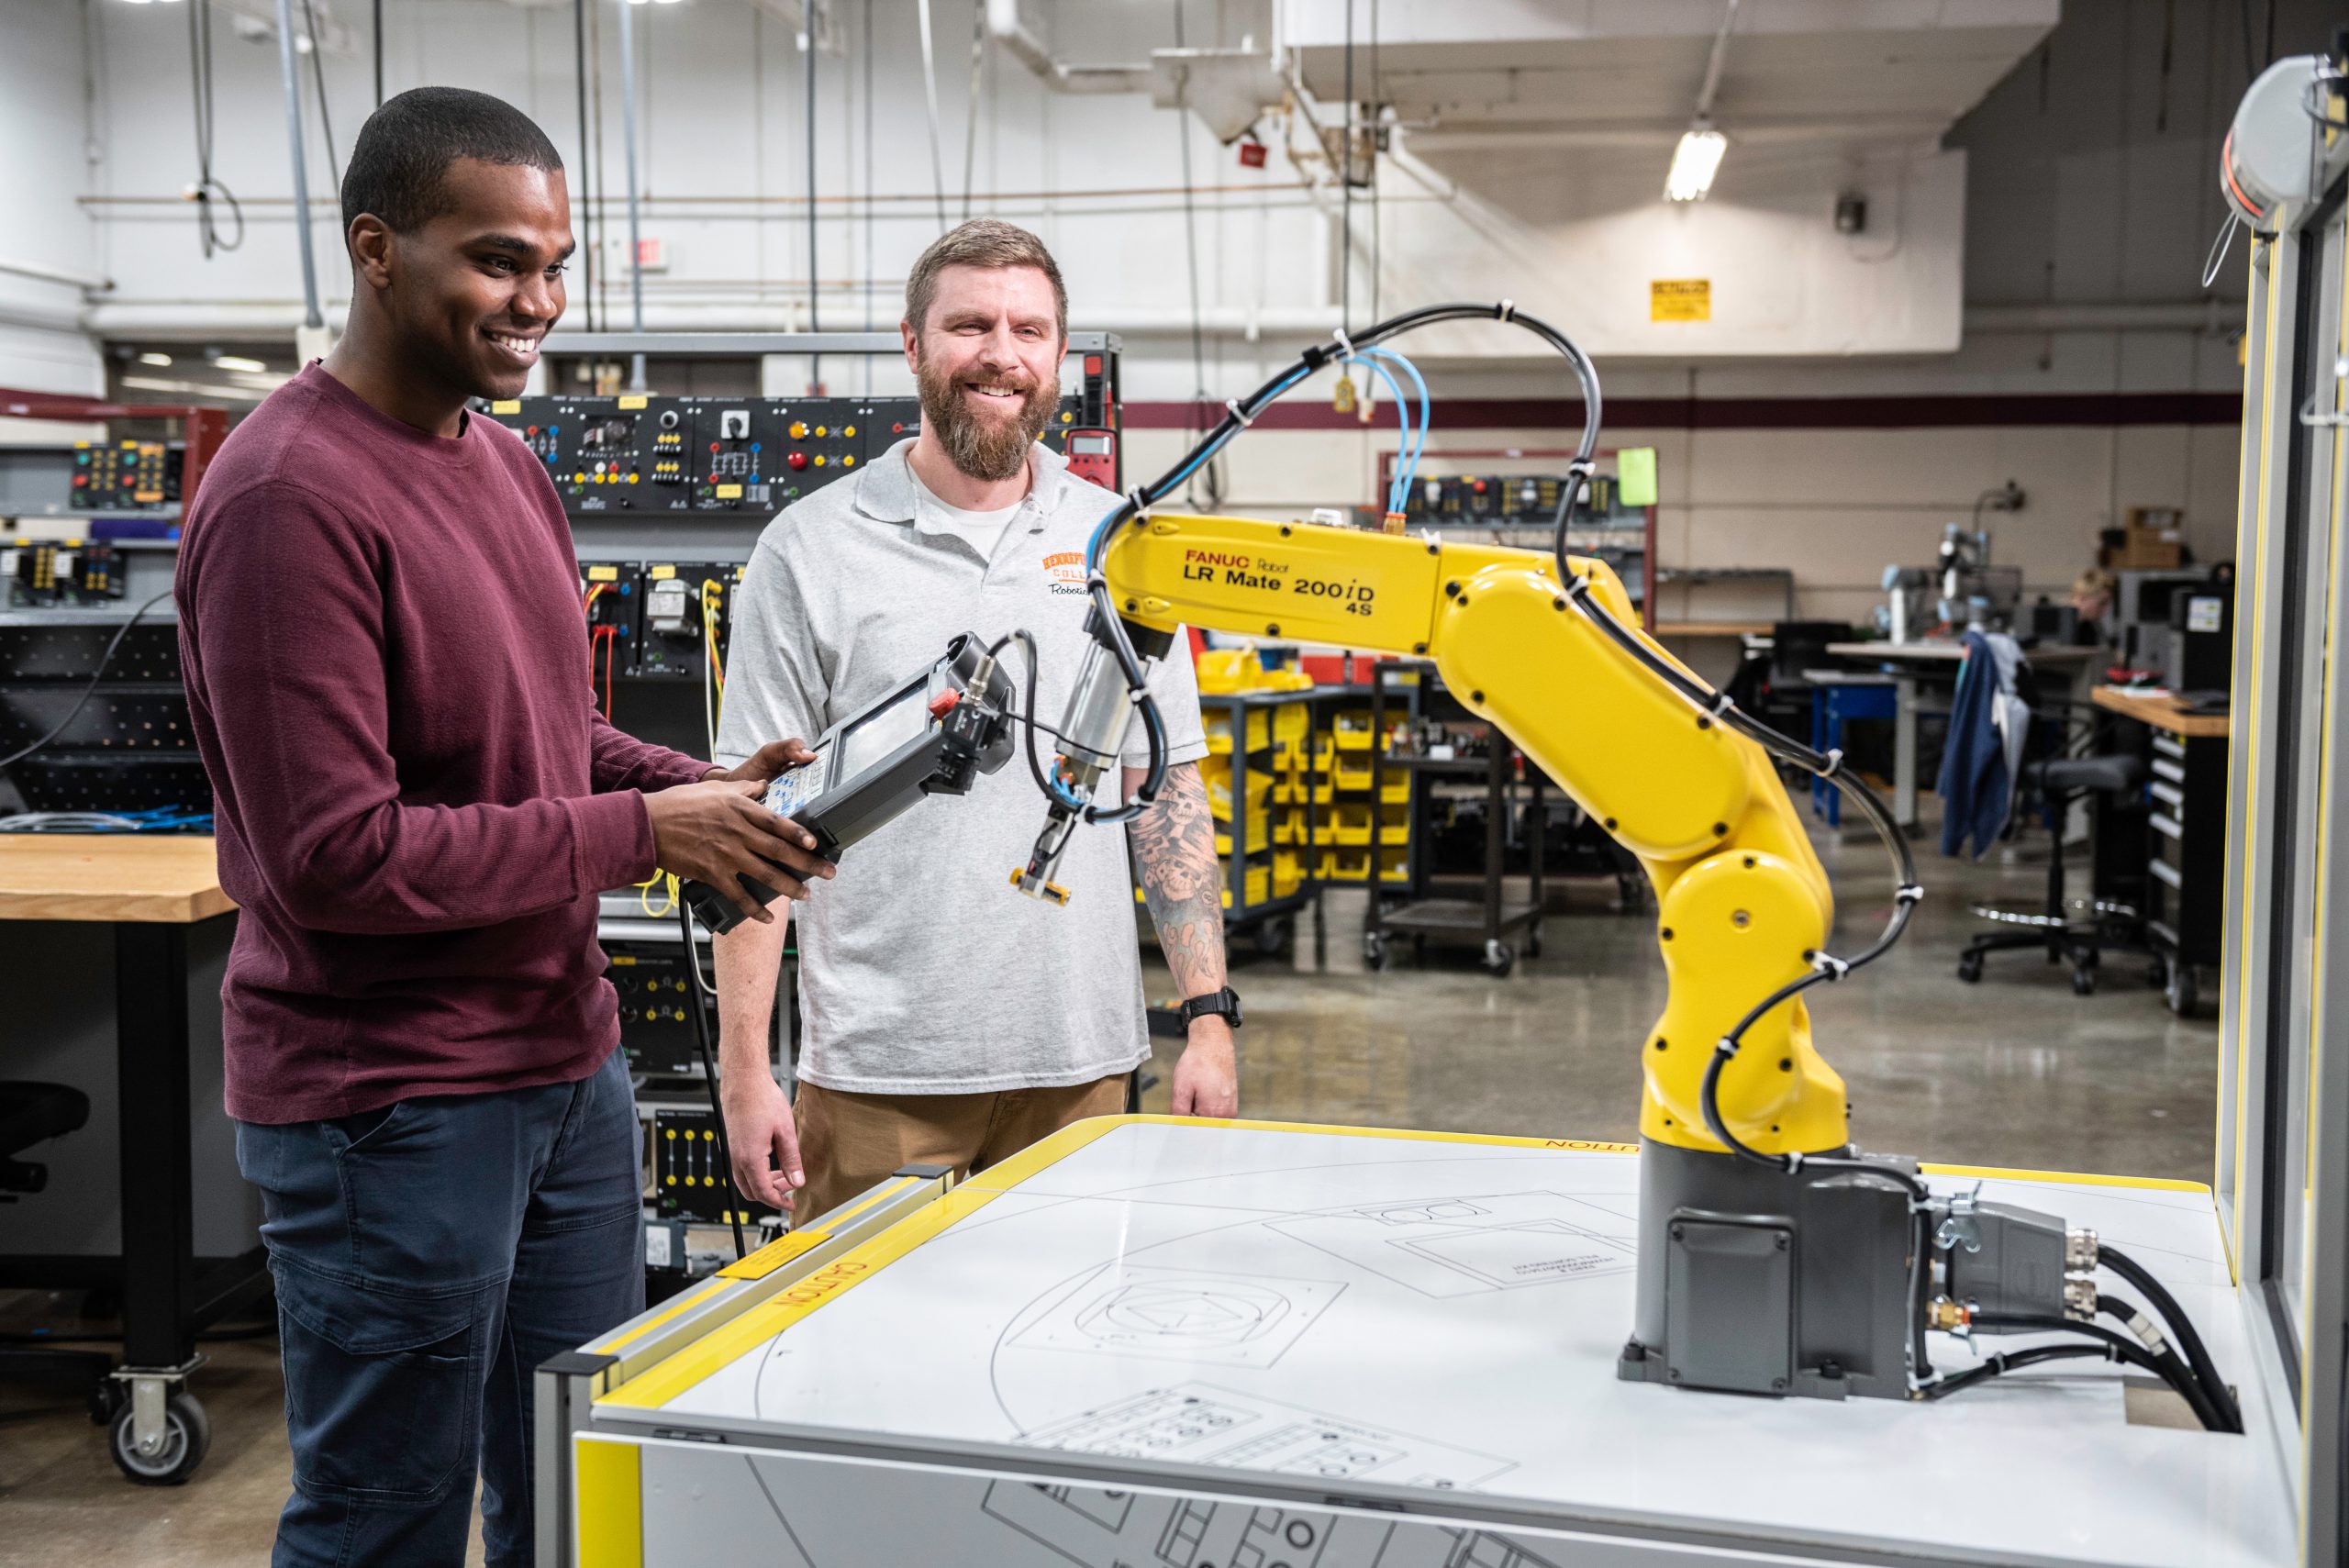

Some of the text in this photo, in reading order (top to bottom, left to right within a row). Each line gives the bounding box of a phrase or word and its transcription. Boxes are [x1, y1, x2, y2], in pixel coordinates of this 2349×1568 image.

[1042, 552, 1086, 571] HENNEPI
[1186, 550, 1289, 573] FANUC Robot
[1053, 569, 1085, 579] COLL
[1048, 583, 1088, 595] Robotic
[1184, 564, 1375, 602] LR Mate 200iD
[1345, 602, 1373, 617] 4S
[1545, 1140, 1641, 1151] UTION
[774, 1262, 867, 1307] CAUTION
